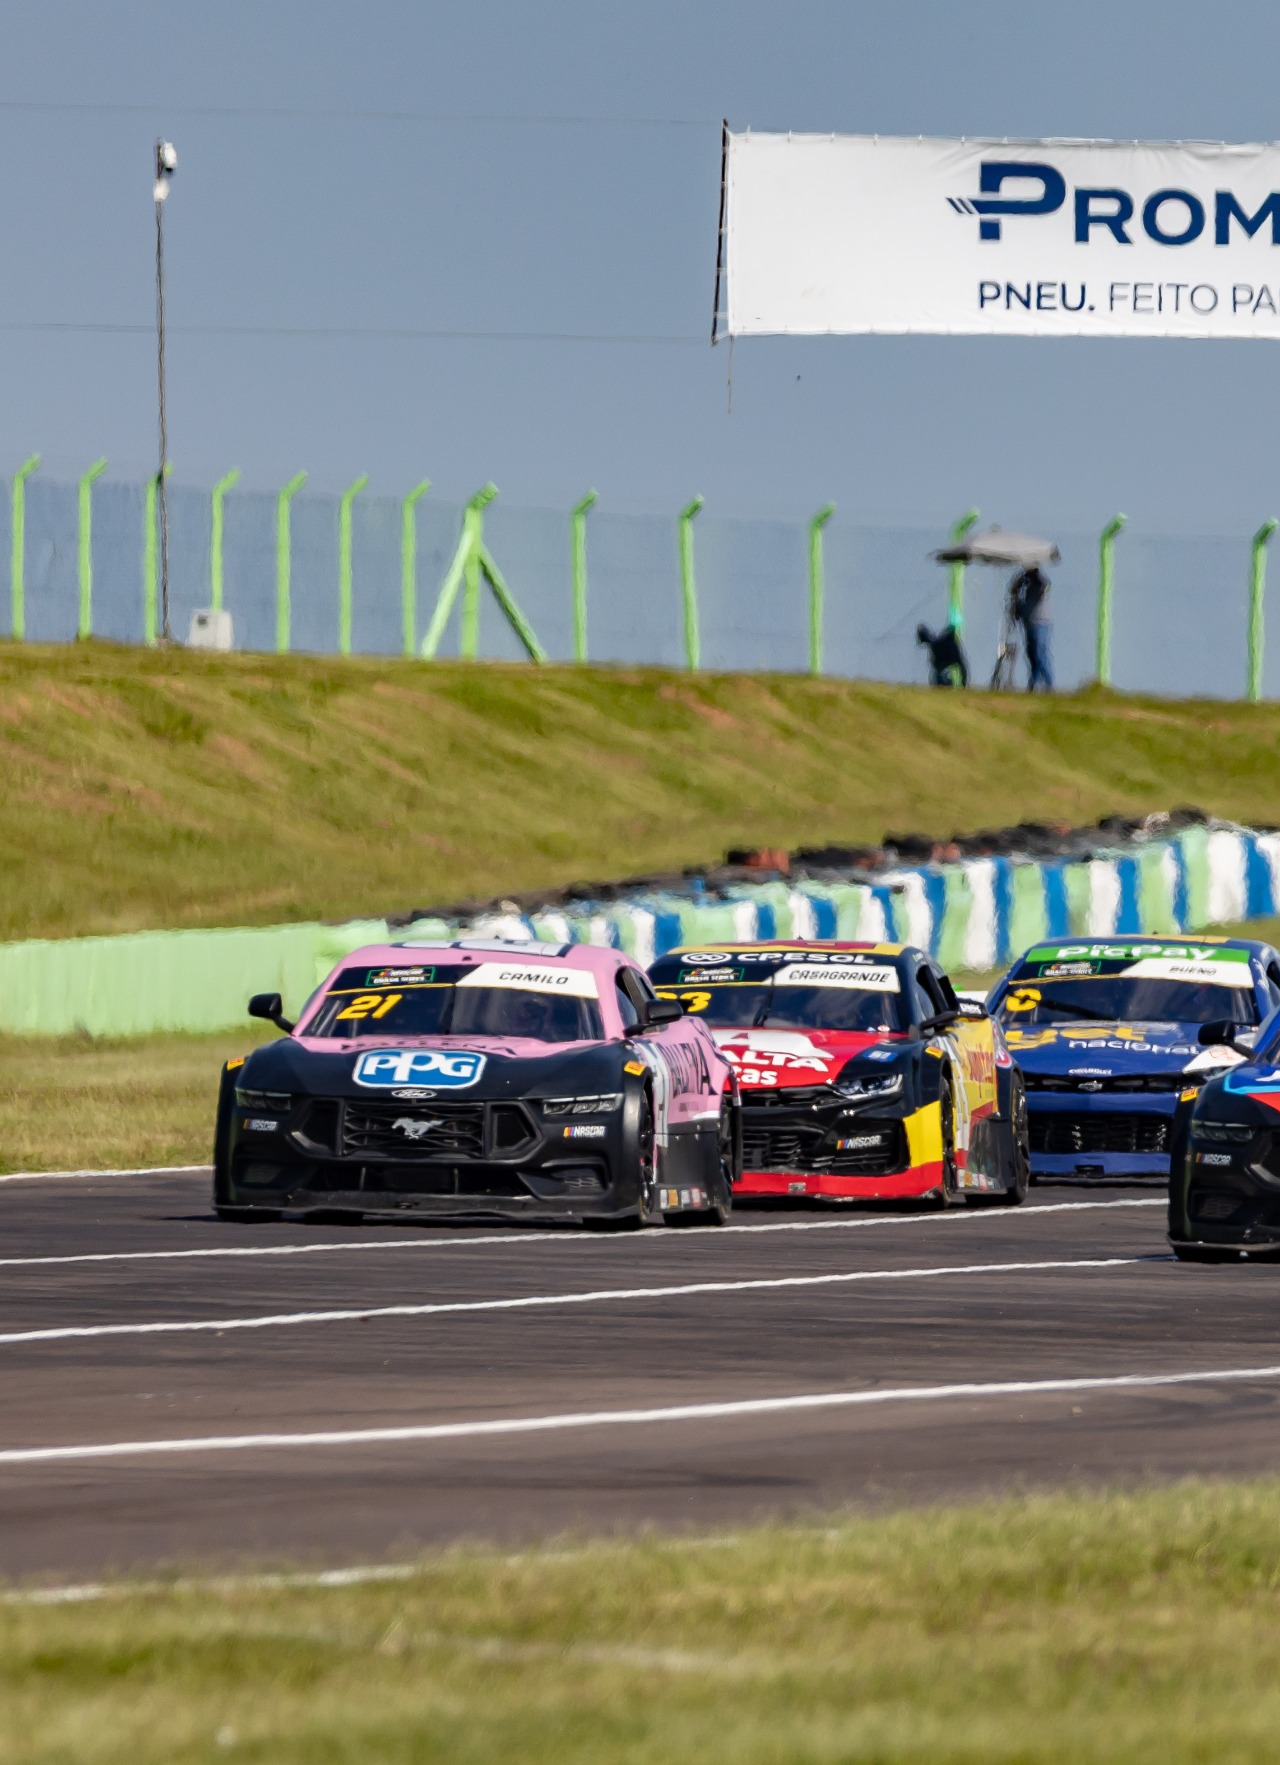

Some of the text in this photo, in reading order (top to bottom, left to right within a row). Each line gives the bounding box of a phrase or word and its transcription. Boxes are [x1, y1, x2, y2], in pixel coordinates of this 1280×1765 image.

[978, 280, 1095, 313] PNEU.
[1109, 282, 1217, 316] FEITO
[499, 971, 569, 986] CAMILO
[789, 970, 890, 983] CASAGRANDE
[336, 994, 403, 1020] 21
[362, 1051, 476, 1083] PPG
[573, 1125, 606, 1138] NASCAR
[847, 1134, 883, 1149] NASCAR
